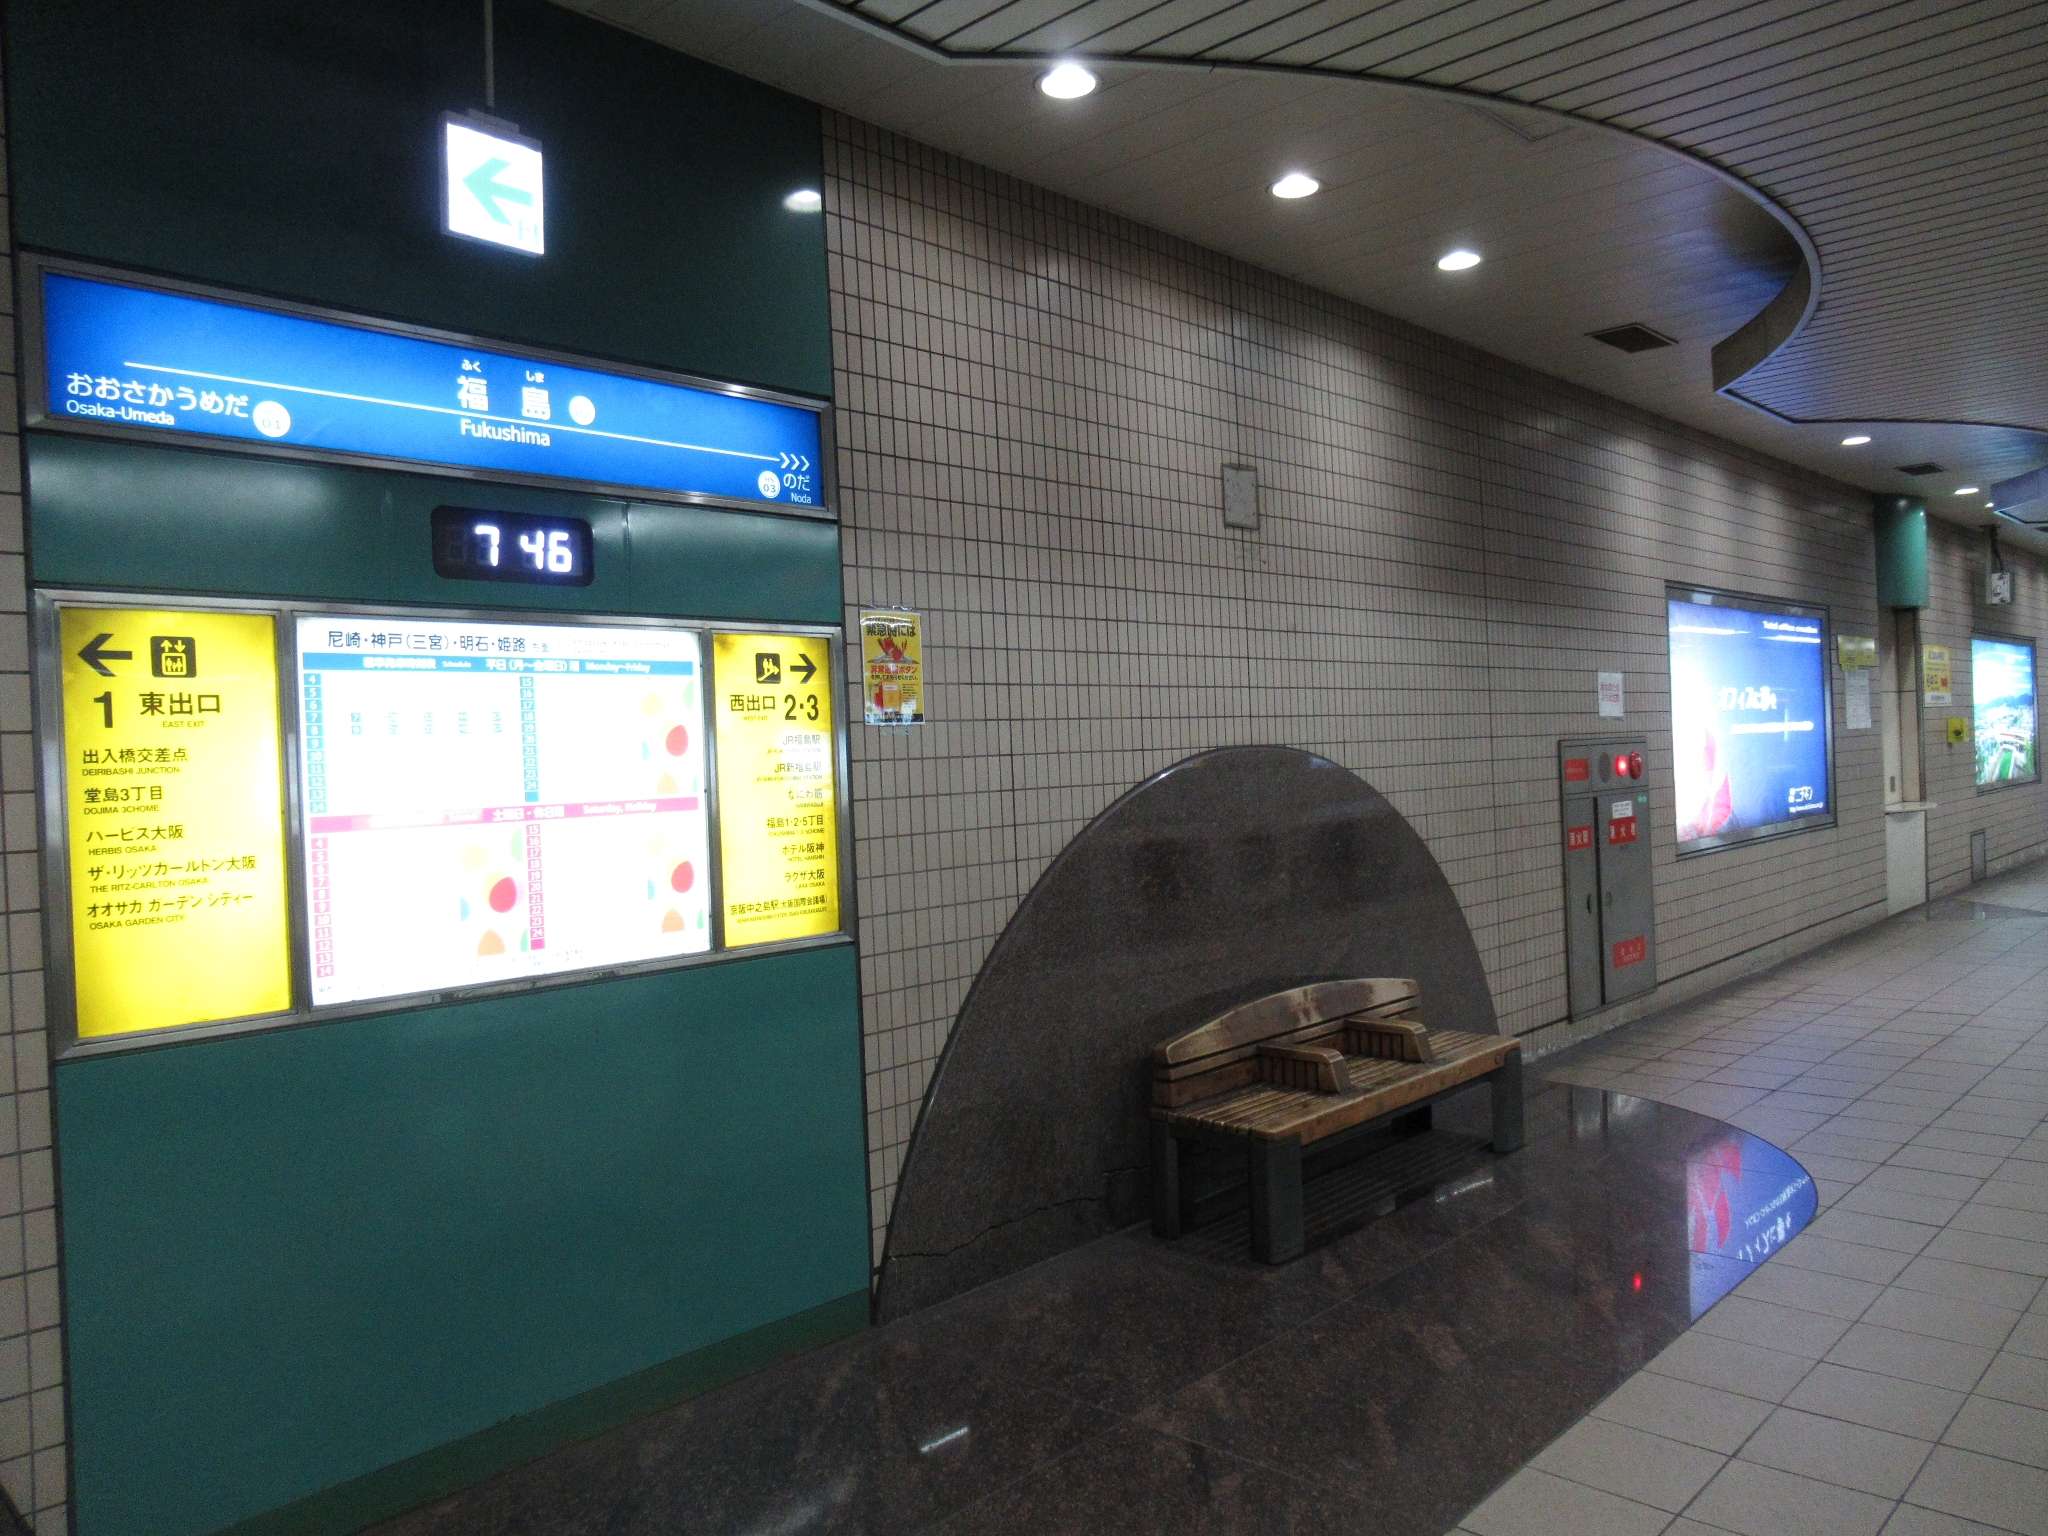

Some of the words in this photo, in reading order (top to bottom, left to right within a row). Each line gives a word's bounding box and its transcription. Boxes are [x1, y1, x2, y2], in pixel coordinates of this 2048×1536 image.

[461, 359, 482, 373] ふく
[66, 371, 249, 418] おおさかうめだ
[457, 375, 551, 421] 福島
[65, 399, 175, 426] Osaka-Umeda
[460, 418, 552, 447] Fukushima
[783, 473, 811, 491] のだ
[790, 492, 812, 504] Noda
[93, 691, 113, 729] 1
[138, 691, 222, 716] 東出口
[730, 694, 776, 712] 西出口
[83, 747, 189, 764] 出入橋交差点
[84, 785, 163, 803] 堂島3丁目
[782, 841, 825, 856] ホテル阪神
[87, 900, 142, 918] オオサカ
